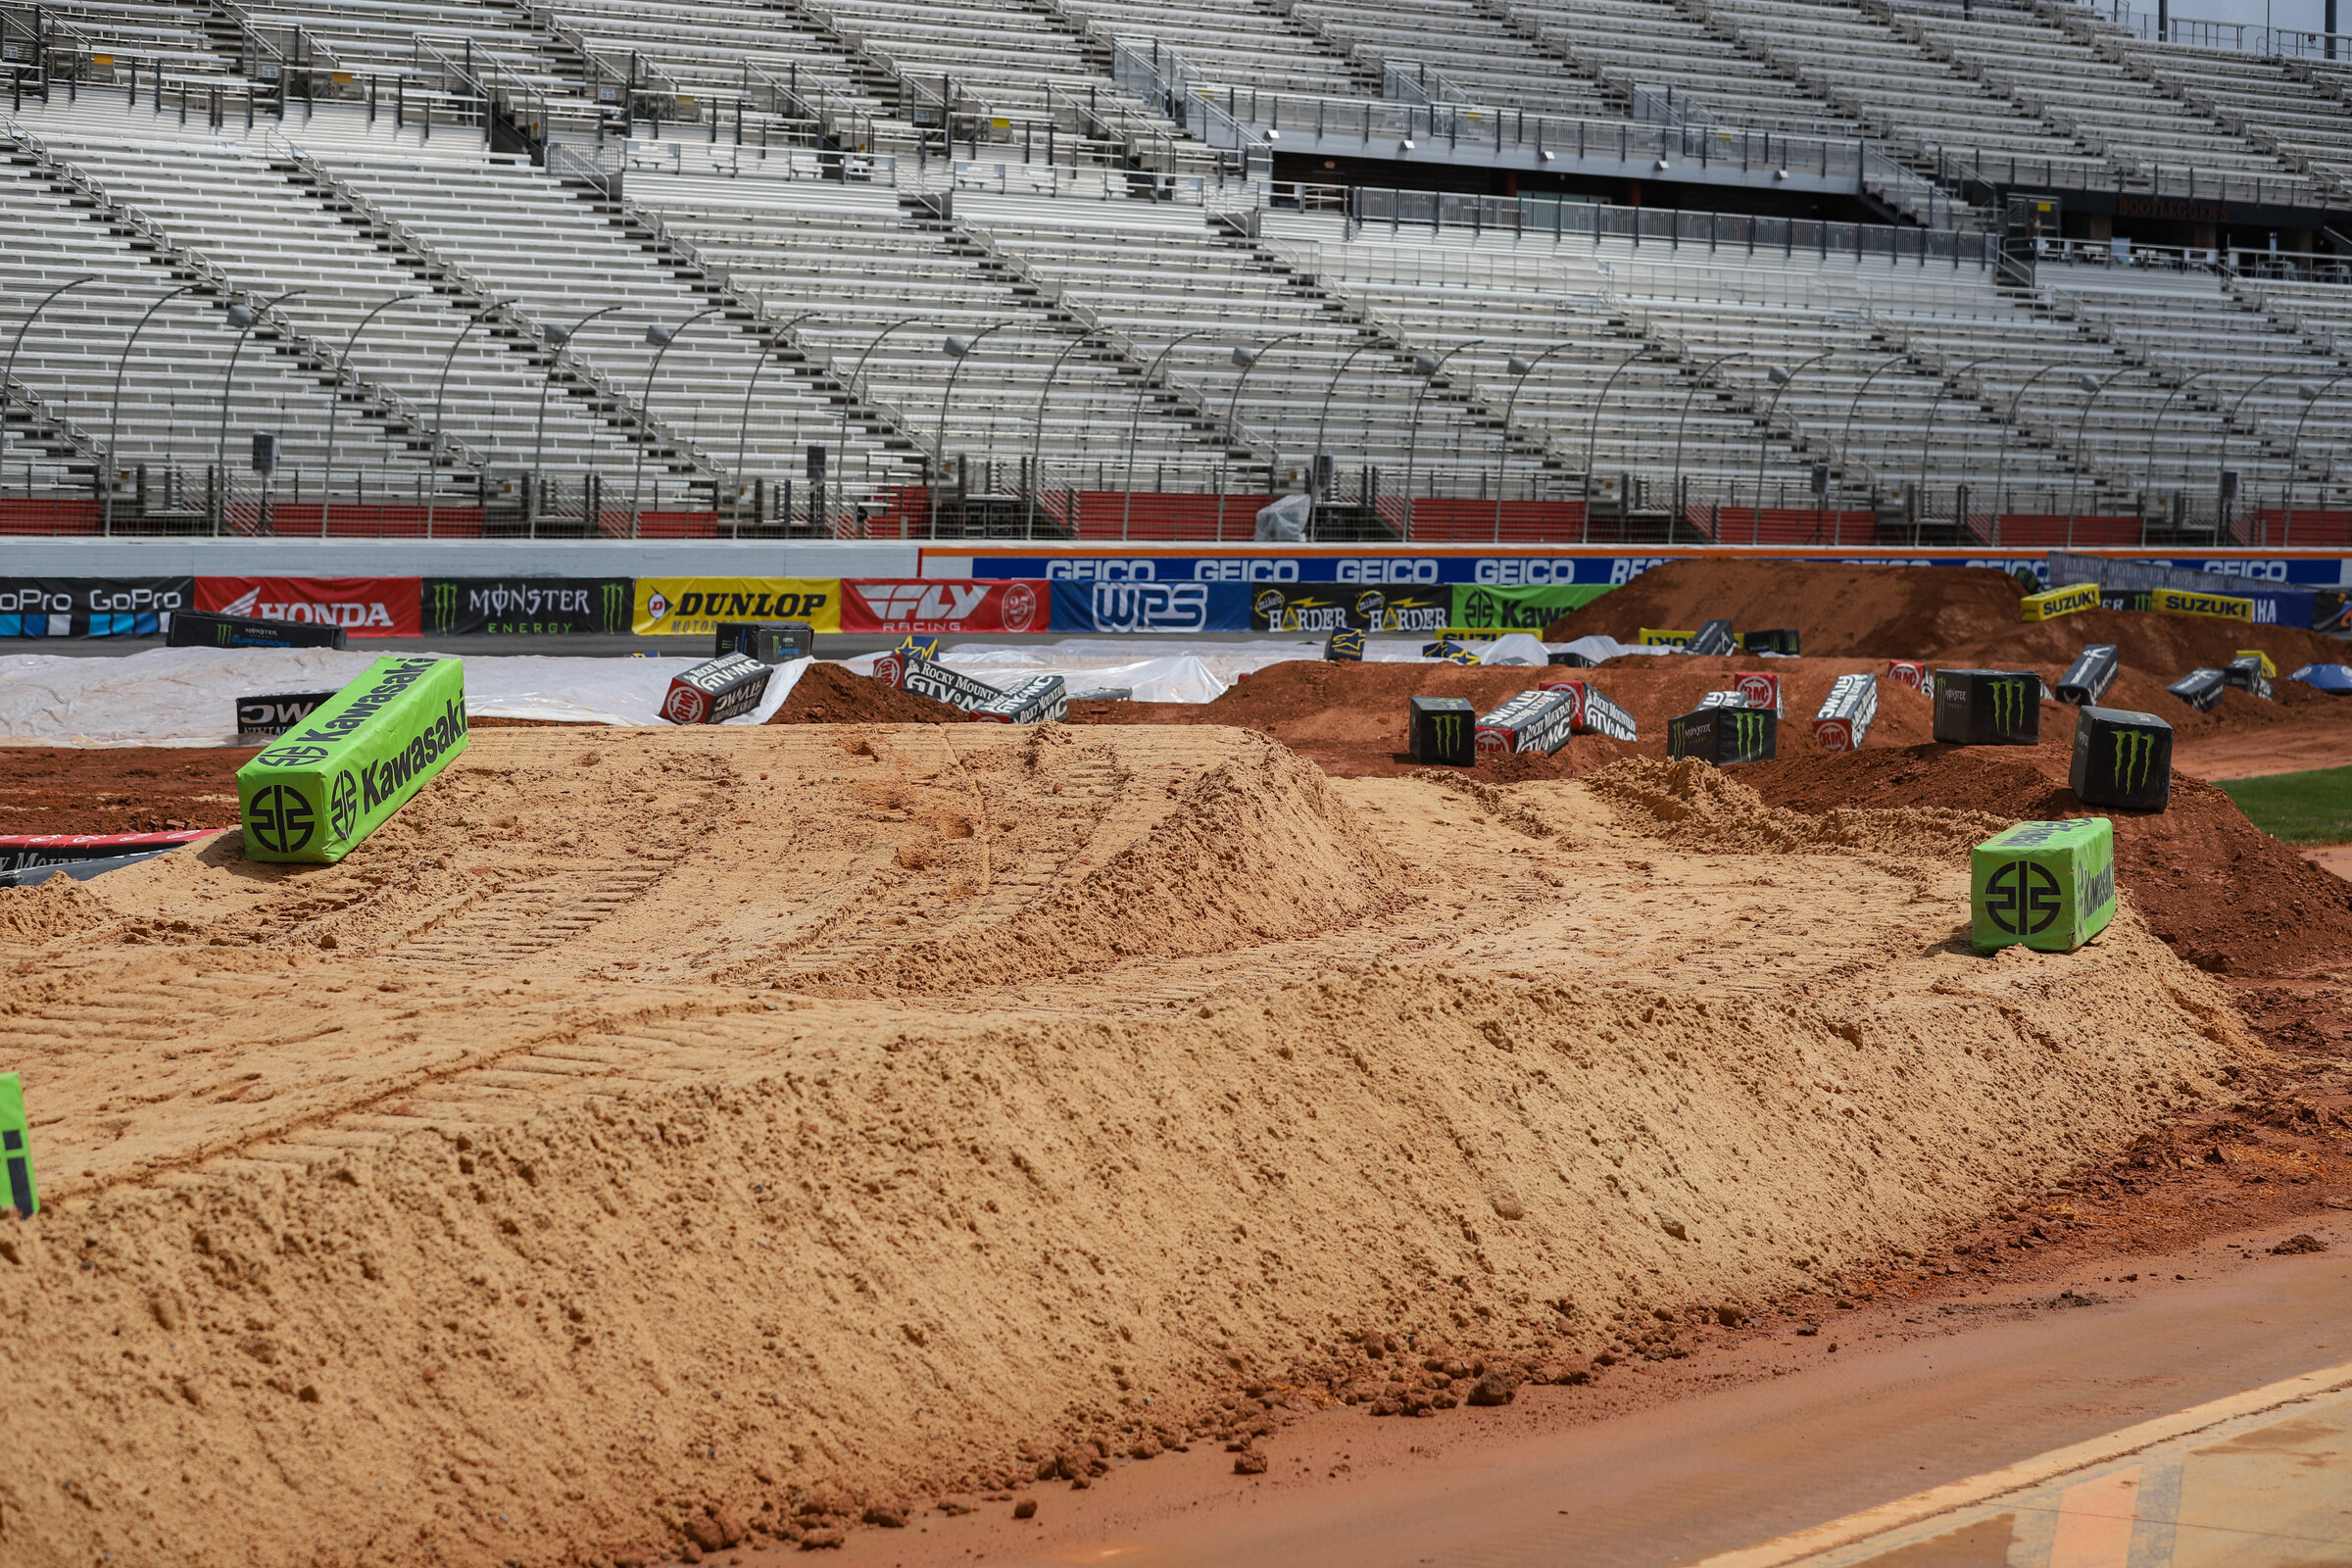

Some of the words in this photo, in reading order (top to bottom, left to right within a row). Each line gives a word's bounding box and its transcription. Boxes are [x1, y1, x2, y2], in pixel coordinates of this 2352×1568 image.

[2118, 198, 2229, 221] BOOTLEGGER'S
[1046, 560, 1155, 581] GEICO
[1195, 560, 1299, 582] GEICO
[1336, 560, 1439, 583] GEICO
[1475, 560, 1575, 584] GEICO
[0, 589, 73, 612] oPro
[89, 588, 182, 611] GoPro
[469, 584, 590, 615] MONSTER
[674, 593, 827, 617] DUNLOP
[1092, 582, 1208, 633] WPS
[2043, 590, 2096, 616] SUZUKI
[2165, 595, 2248, 617] SUZUKI
[260, 602, 393, 627] HONDA
[488, 622, 571, 634] ENERGY
[883, 621, 962, 632] RACING
[921, 662, 955, 685] ROCKY
[955, 675, 1000, 701] MOUNT
[362, 690, 467, 815] Kawasaki
